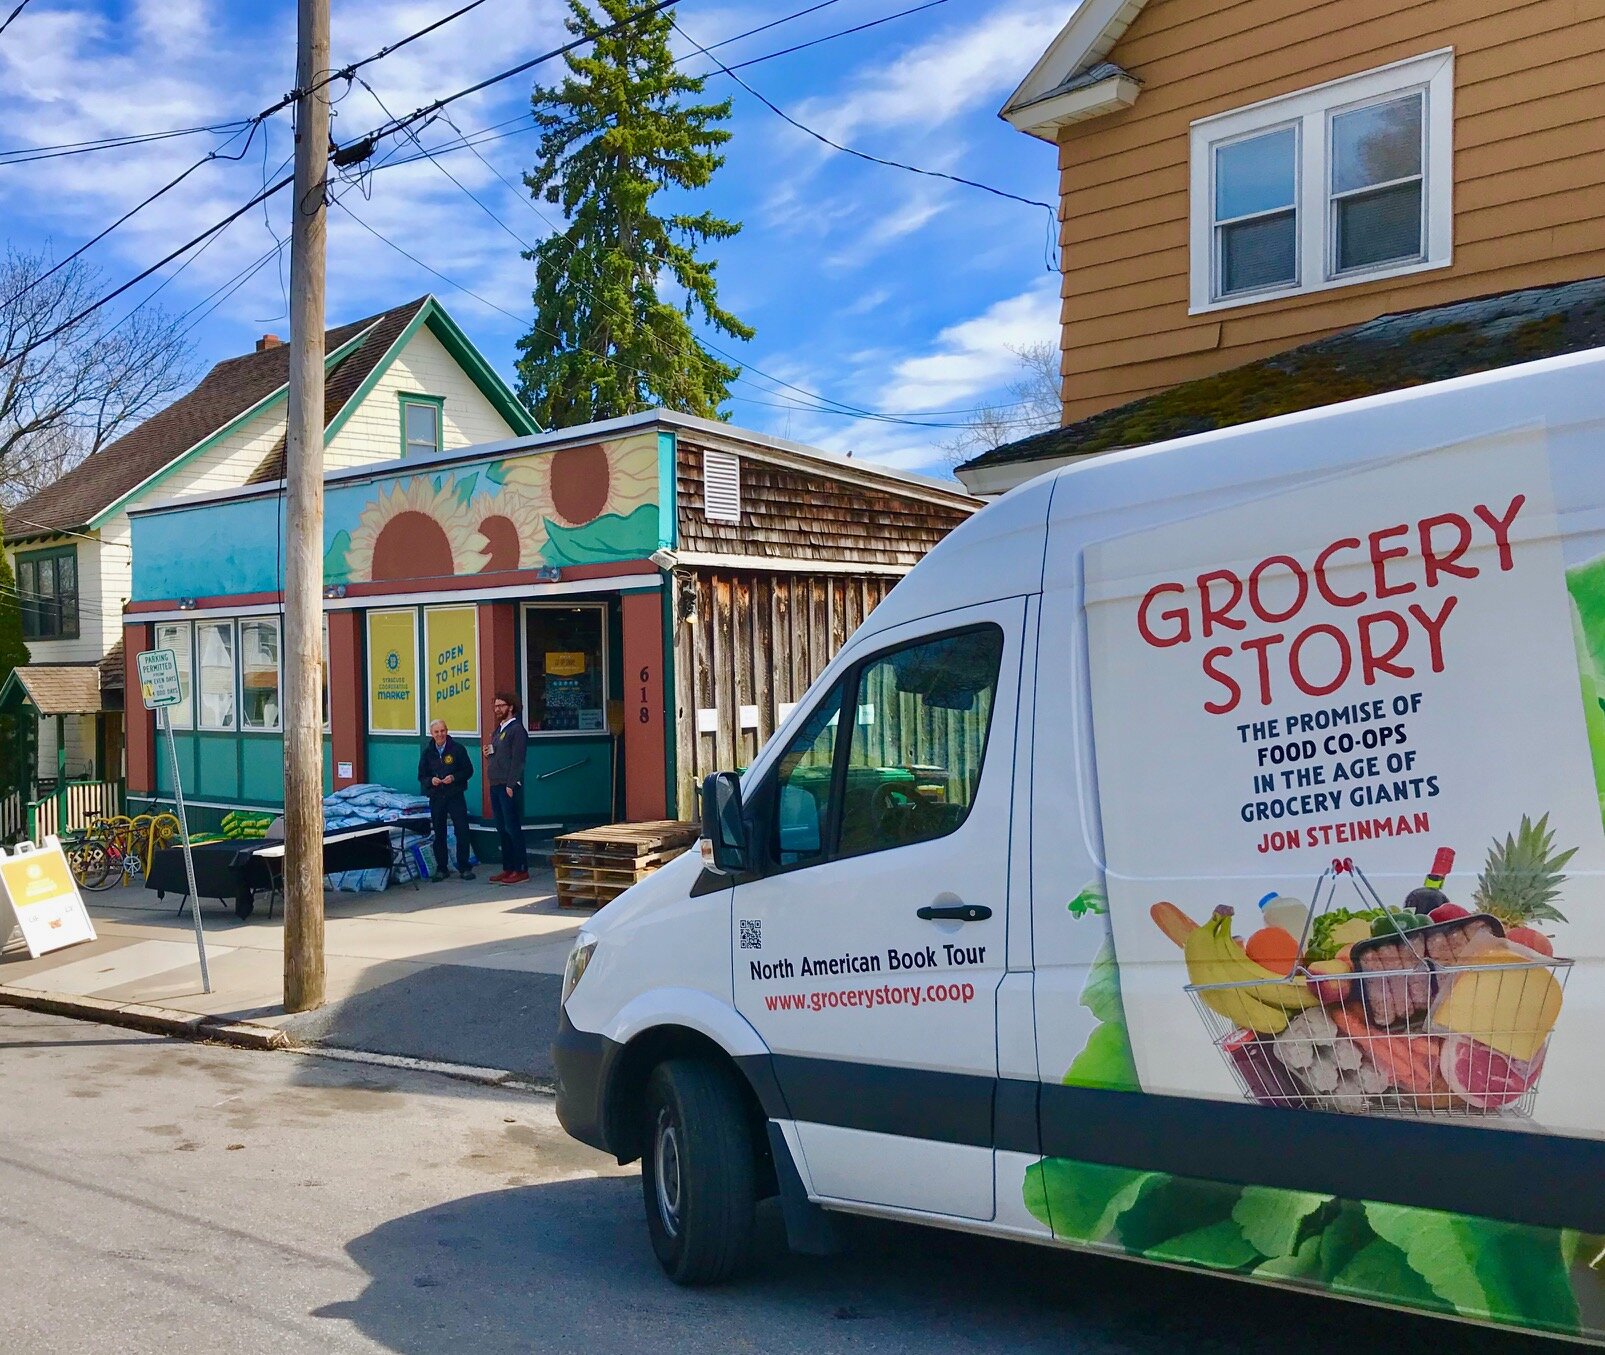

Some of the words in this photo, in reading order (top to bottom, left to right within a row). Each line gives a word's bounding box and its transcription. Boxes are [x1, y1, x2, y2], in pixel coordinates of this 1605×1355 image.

[1138, 494, 1526, 647] GROCERY
[143, 663, 172, 673] PERMITTED
[145, 654, 168, 663] PARKING
[436, 670, 448, 684] TO
[451, 660, 469, 677] THE
[438, 644, 464, 665] OPEN
[1202, 595, 1458, 714] STORY
[436, 678, 471, 703] PUBLIC
[1237, 719, 1280, 743] THE
[1286, 699, 1386, 735] PROMISE
[1392, 692, 1423, 715] OF
[1257, 740, 1317, 766] FOOD
[1323, 723, 1407, 755] CO-OPS
[1253, 773, 1275, 794] IN
[1280, 765, 1326, 789] THE
[1332, 757, 1380, 782] AGE
[1386, 750, 1416, 773] OF
[1241, 790, 1342, 823] GROCERY
[1349, 775, 1440, 807] GIANTS
[1257, 829, 1300, 854] JON
[1306, 812, 1430, 847] STEINMAN
[750, 958, 794, 980] North
[800, 953, 881, 977] American
[887, 945, 938, 970] Book
[943, 943, 986, 966] Tour
[765, 982, 975, 1011] www.grocerystory.coop
